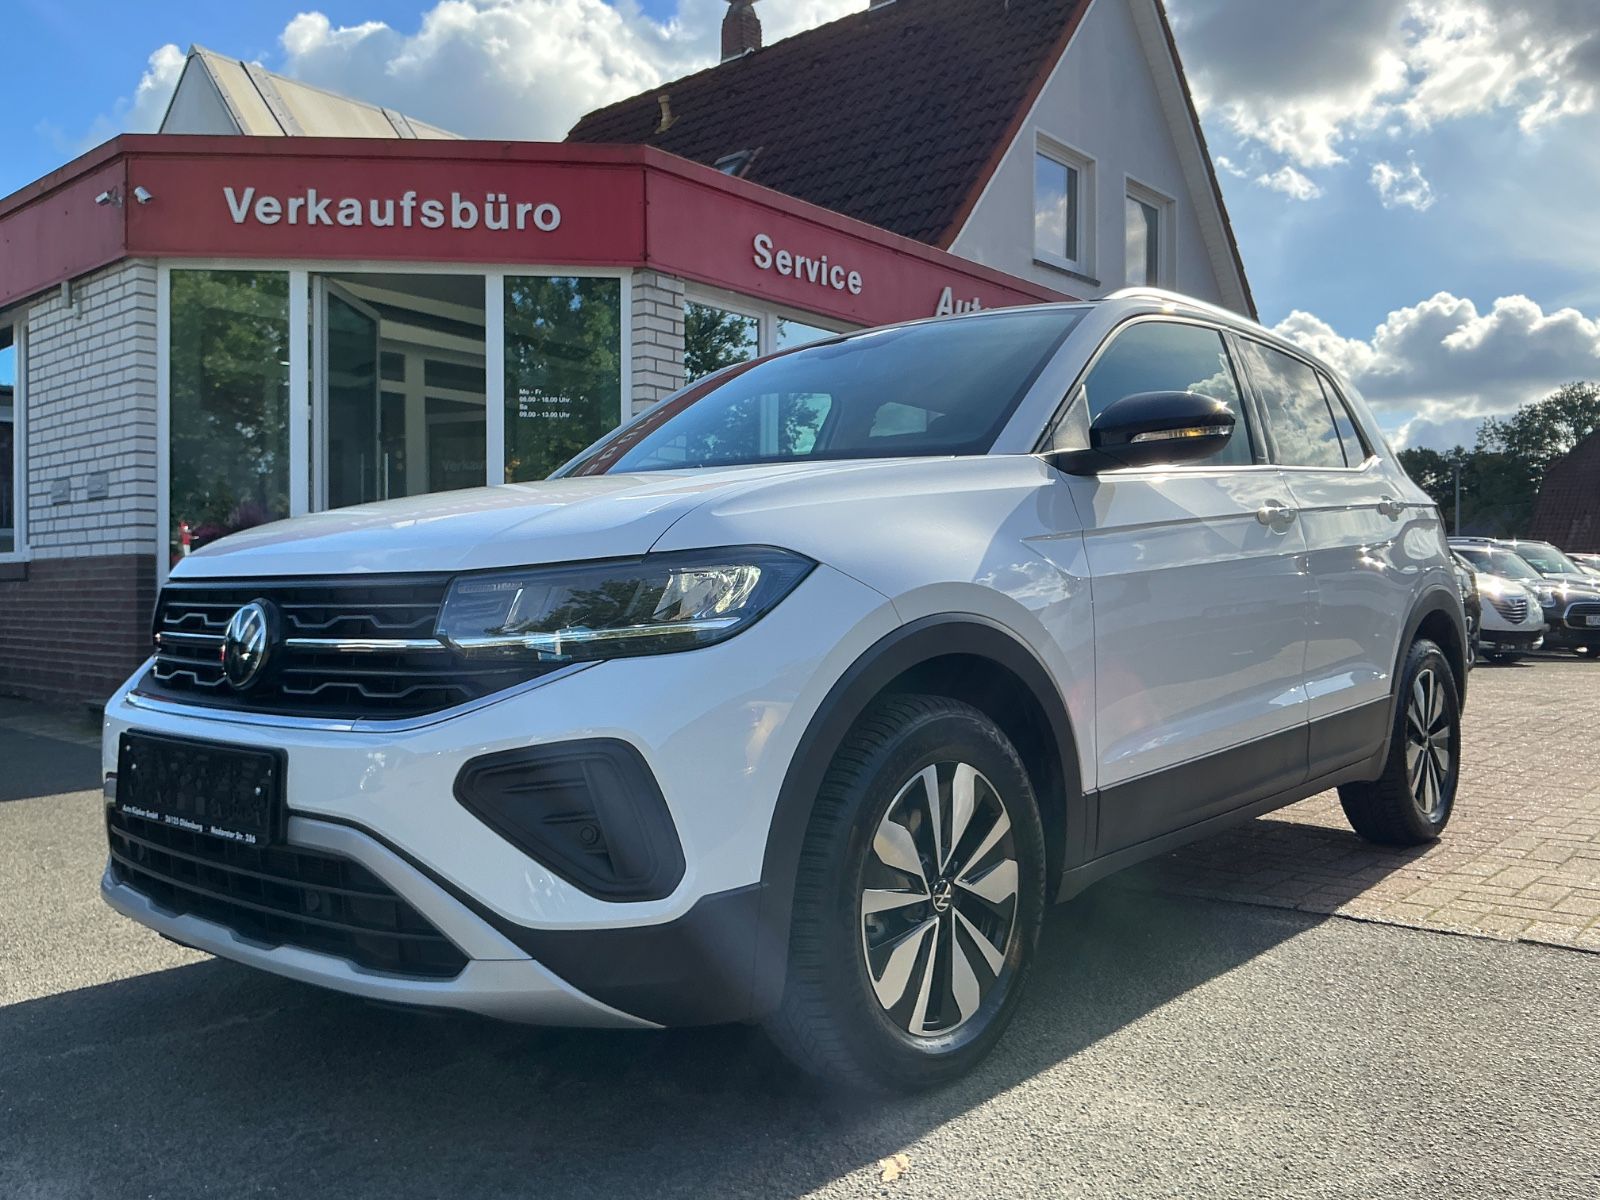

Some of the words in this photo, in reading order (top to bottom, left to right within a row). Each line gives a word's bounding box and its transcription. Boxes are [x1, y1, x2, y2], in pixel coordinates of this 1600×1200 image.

[223, 187, 561, 231] Verkaufsbüro
[753, 233, 863, 295] Service
[936, 286, 990, 317] Aut
